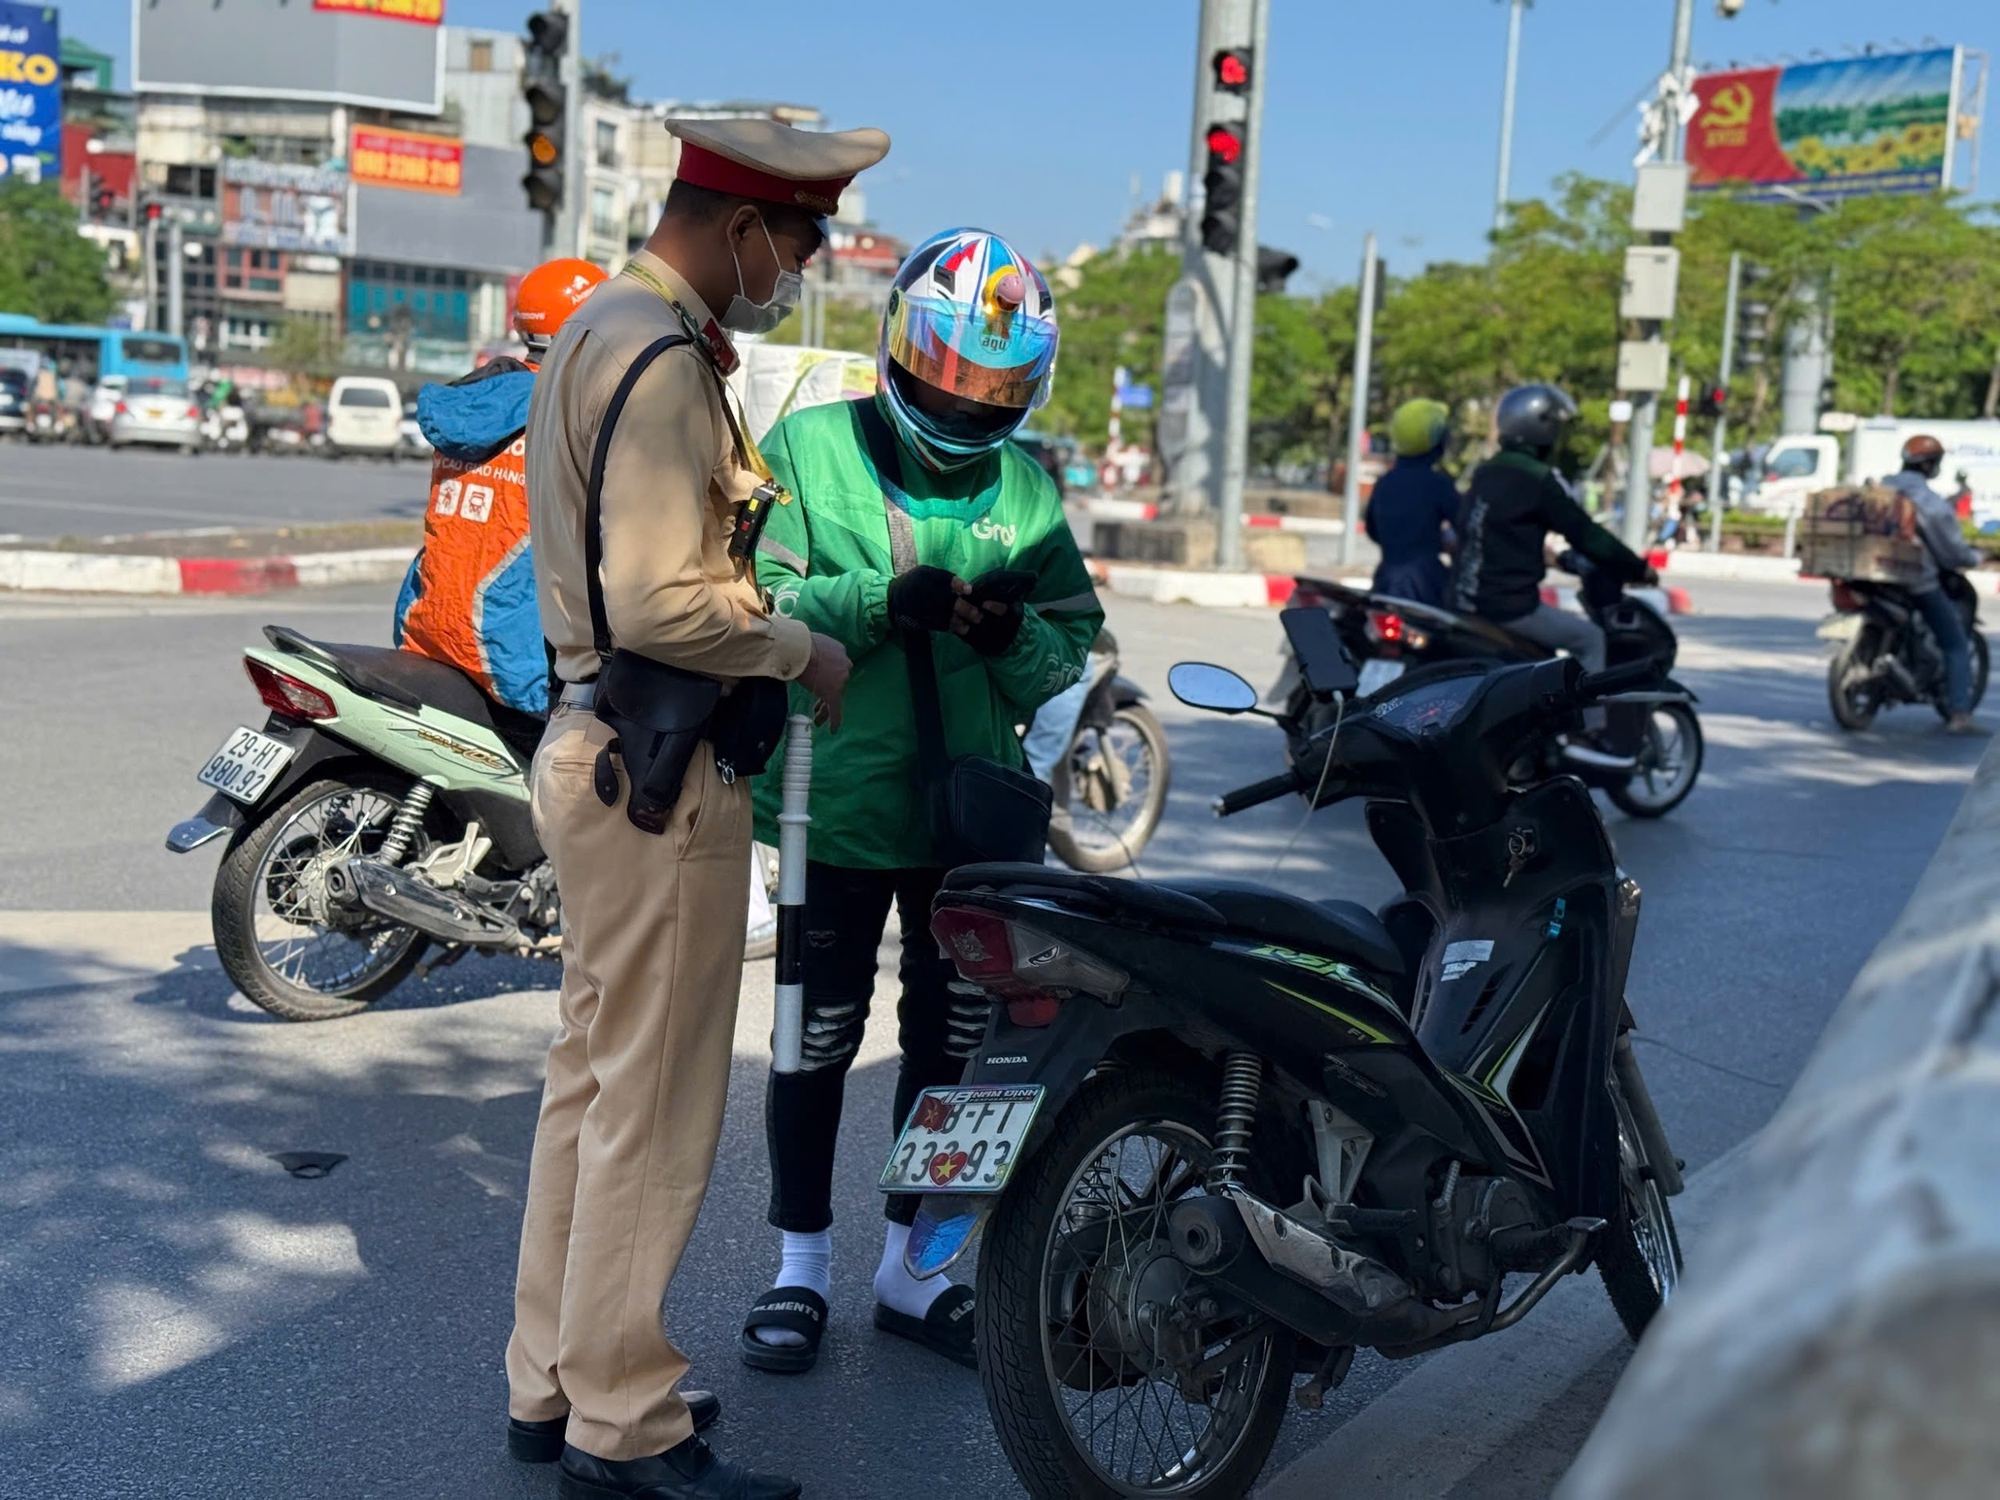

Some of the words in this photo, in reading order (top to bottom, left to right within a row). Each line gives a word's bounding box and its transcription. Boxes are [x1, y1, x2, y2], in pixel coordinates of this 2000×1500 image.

[228, 732, 283, 770] 29-H1
[204, 755, 267, 799] 980.92
[986, 1056, 1028, 1065] HONDA
[972, 1090, 1002, 1098] NAM
